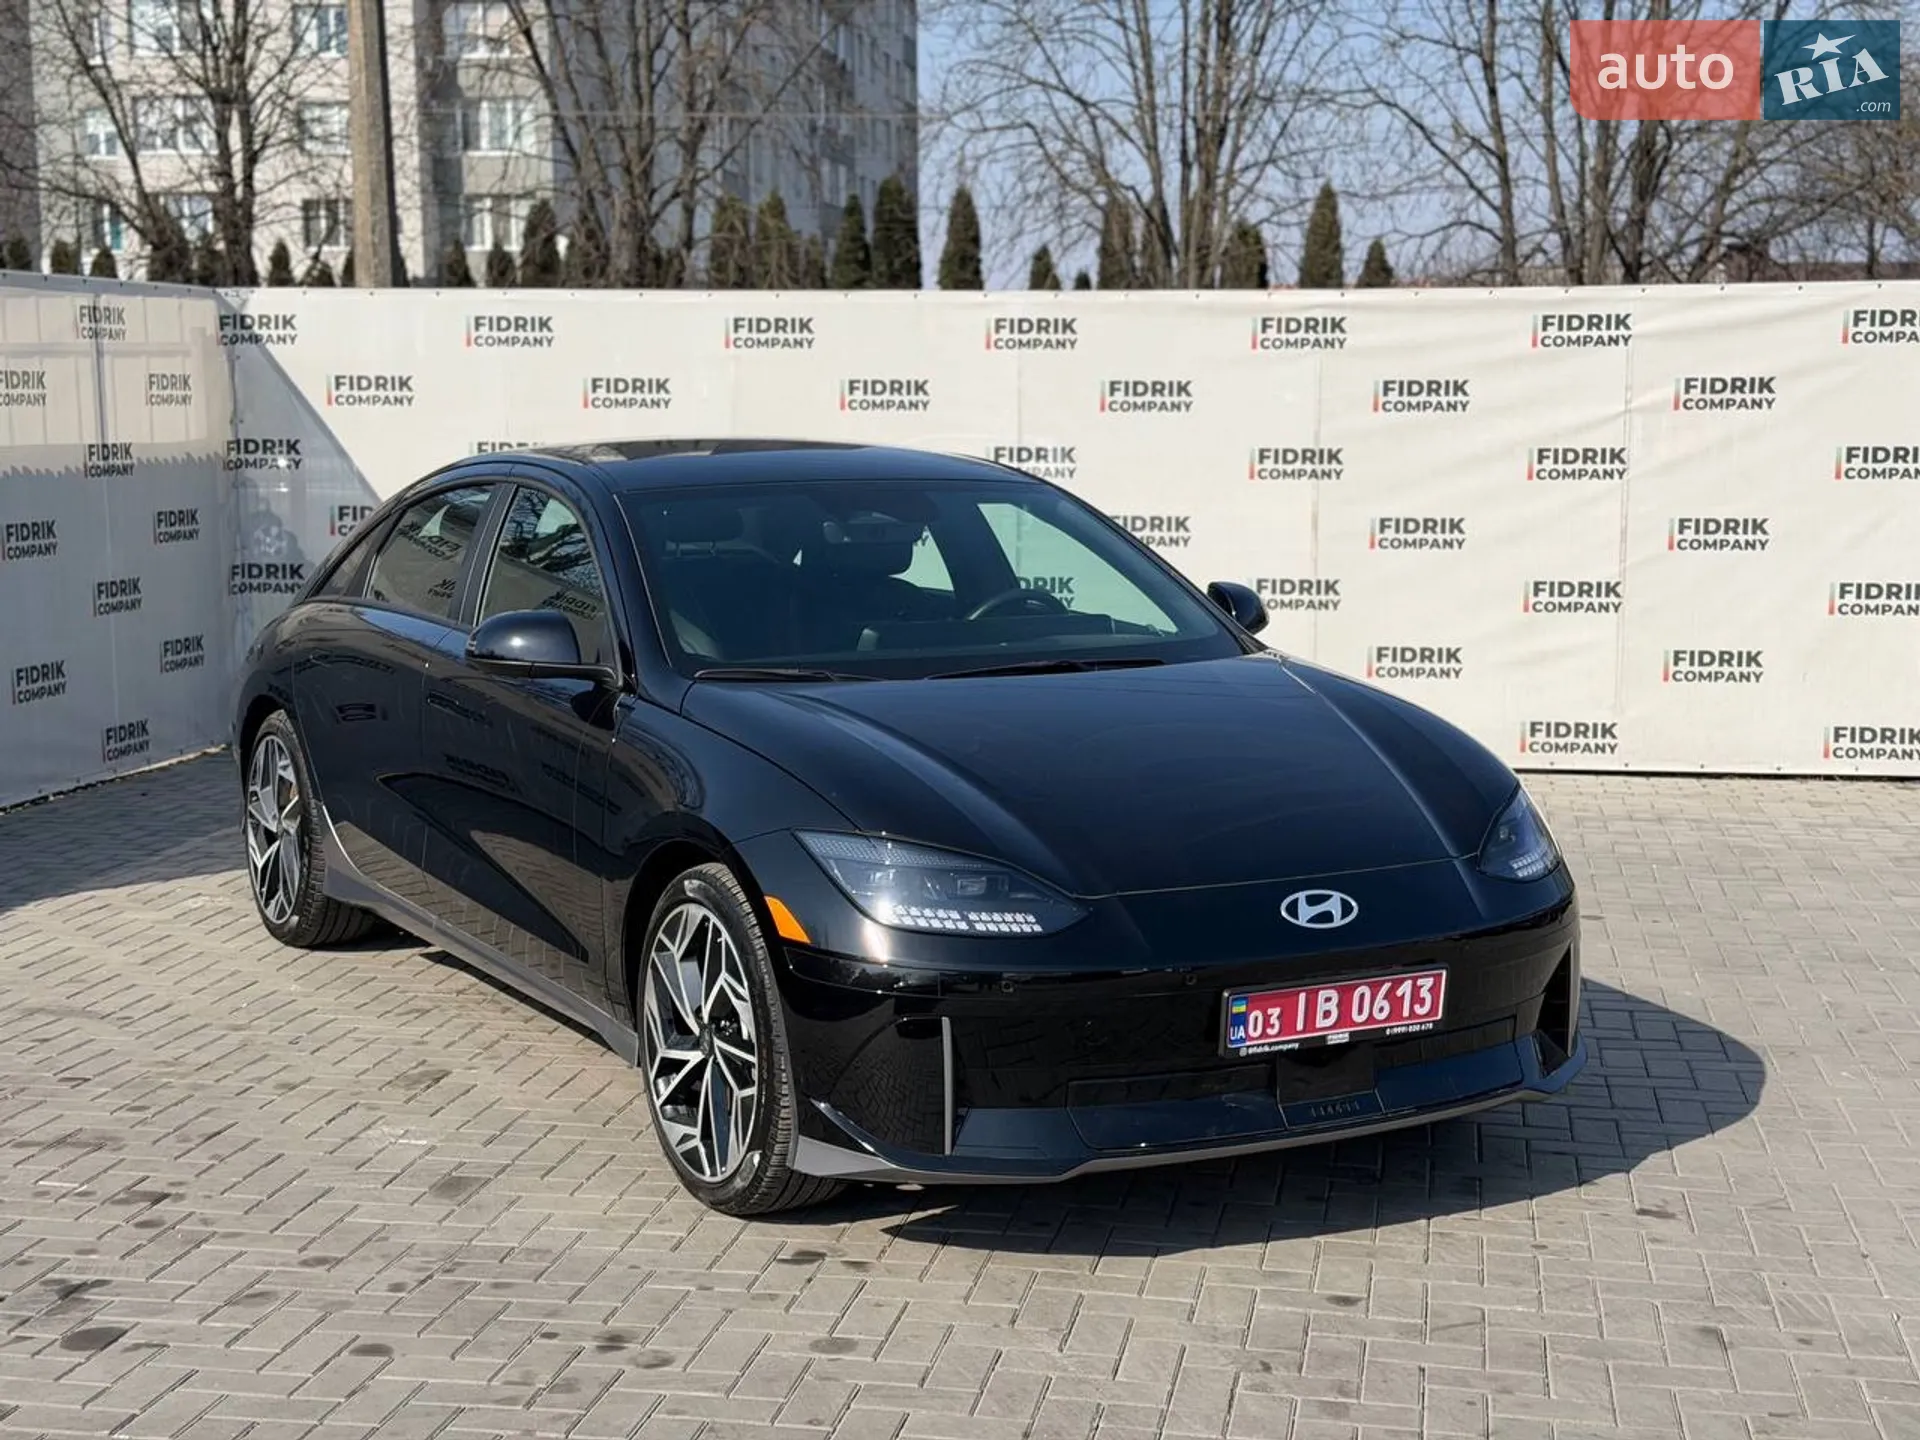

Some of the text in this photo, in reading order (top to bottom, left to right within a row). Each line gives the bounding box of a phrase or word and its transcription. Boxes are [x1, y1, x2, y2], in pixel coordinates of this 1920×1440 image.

[79, 305, 126, 326] FIDRIK
[218, 314, 297, 331] FIDRIK
[1541, 313, 1632, 332] FIDRIK
[474, 316, 553, 333] FIDRIK
[733, 317, 814, 334] FIDRIK
[994, 318, 1077, 335] FIDRIK
[1261, 316, 1347, 334] FIDRIK
[80, 326, 127, 341] COMPANY
[220, 333, 298, 346] COMPANY
[473, 335, 555, 347] COMPANY
[1540, 334, 1632, 348] COMPANY
[733, 337, 815, 349] COMPANY
[993, 337, 1078, 350] COMPANY
[1260, 337, 1347, 350] COMPANY
[148, 374, 192, 391] FIDRIK
[334, 375, 414, 392] FIDRIK
[591, 378, 671, 394] FIDRIK
[849, 380, 930, 396] FIDRIK
[1108, 381, 1192, 397] FIDRIK
[1382, 379, 1470, 397] FIDRIK
[1684, 376, 1776, 395] FIDRIK
[149, 394, 193, 407] COMPANY
[334, 394, 415, 406] COMPANY
[591, 397, 672, 409] COMPANY
[848, 399, 930, 411] COMPANY
[1108, 400, 1193, 413] COMPANY
[1382, 400, 1470, 413] COMPANY
[1683, 398, 1776, 411] COMPANY
[88, 442, 133, 462] FIDRIK
[226, 438, 301, 457] FIDRIK
[993, 446, 1076, 464] FIDRIK
[1258, 448, 1343, 465] FIDRIK
[1536, 447, 1627, 466] FIDRIK
[88, 463, 135, 478] COMPANY
[1257, 468, 1344, 481] COMPANY
[1536, 468, 1628, 481] COMPANY
[157, 508, 199, 529] FIDRIK
[1379, 517, 1466, 535] FIDRIK
[1678, 518, 1769, 536] FIDRIK
[6, 520, 57, 542] FIDRIK
[157, 528, 200, 545] COMPANY
[7, 542, 58, 560] COMPANY
[1378, 538, 1466, 550] COMPANY
[1677, 539, 1770, 551] COMPANY
[231, 563, 305, 581] FIDRIK
[97, 577, 141, 601] FIDRIK
[1256, 578, 1341, 596] FIDRIK
[1532, 581, 1622, 598] FIDRIK
[97, 599, 143, 617] COMPANY
[1532, 601, 1623, 613] COMPANY
[163, 635, 205, 657] FIDRIK
[1376, 646, 1463, 664] FIDRIK
[1672, 650, 1764, 668] FIDRIK
[164, 655, 205, 674] COMPANY
[1375, 667, 1463, 679] COMPANY
[15, 660, 66, 688] FIDRIK
[1672, 670, 1764, 683] COMPANY
[17, 682, 67, 704] COMPANY
[105, 719, 149, 746] FIDRIK
[1529, 721, 1618, 740] FIDRIK
[106, 739, 151, 762] COMPANY
[1528, 741, 1619, 755] COMPANY
[1249, 977, 1435, 1038] 03 IB 0613
[1230, 1024, 1246, 1041] UA
